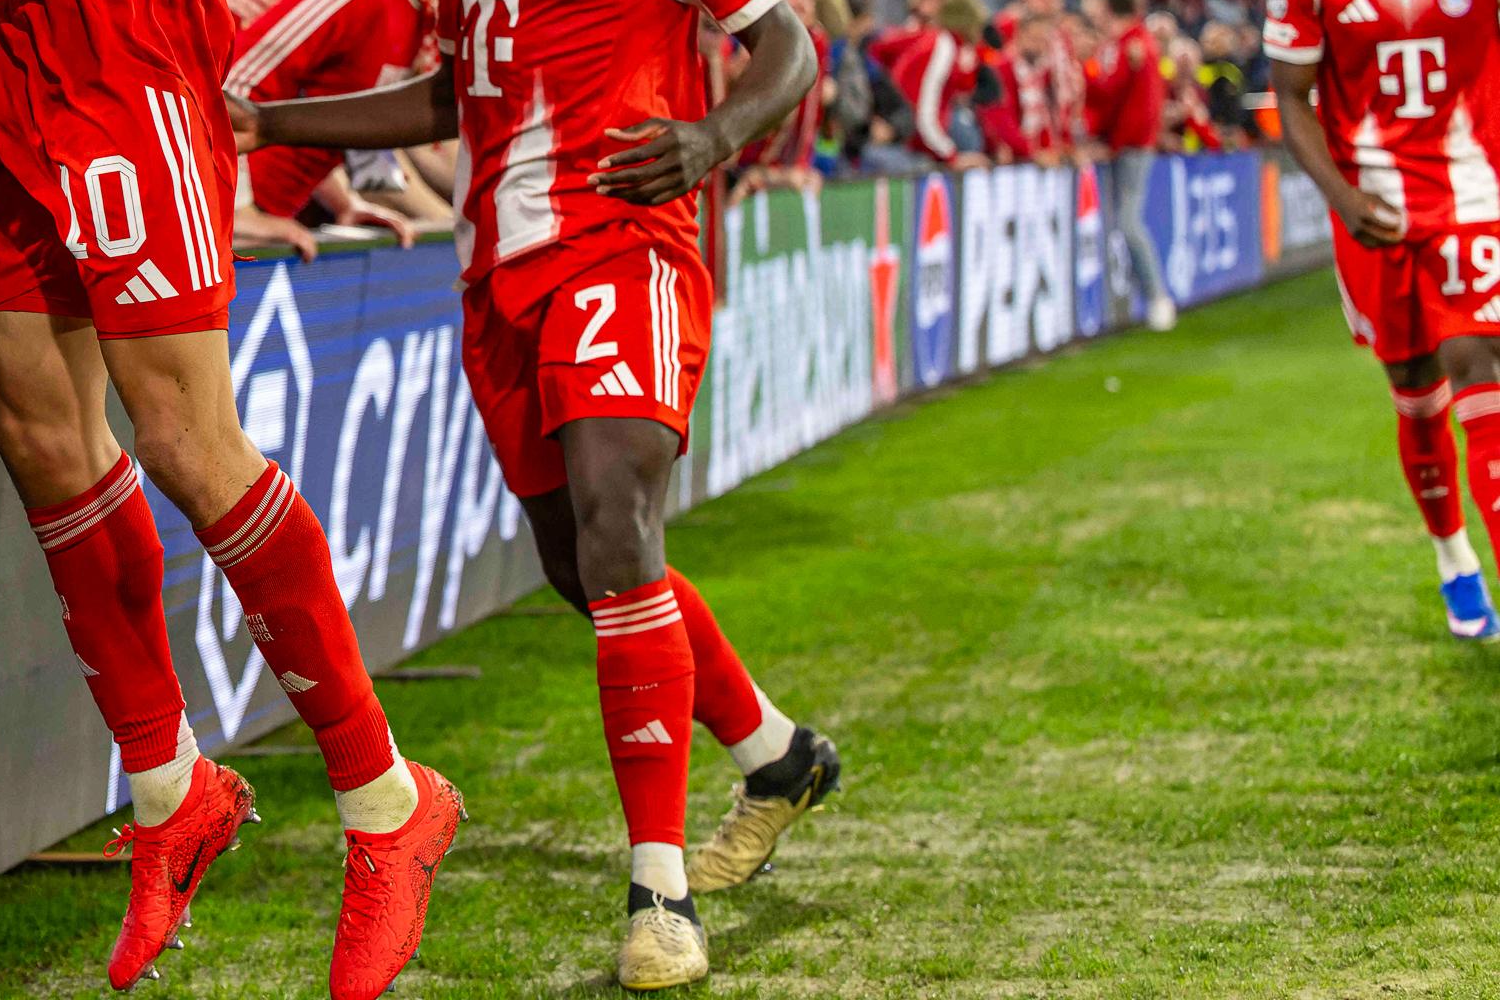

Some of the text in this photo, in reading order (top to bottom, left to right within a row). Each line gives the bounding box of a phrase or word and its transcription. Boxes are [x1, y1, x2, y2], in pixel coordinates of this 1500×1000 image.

[1377, 37, 1447, 118] T
[60, 155, 147, 258] 10
[1439, 234, 1500, 296] 19
[574, 284, 618, 364] 2
[328, 324, 521, 650] cryp
